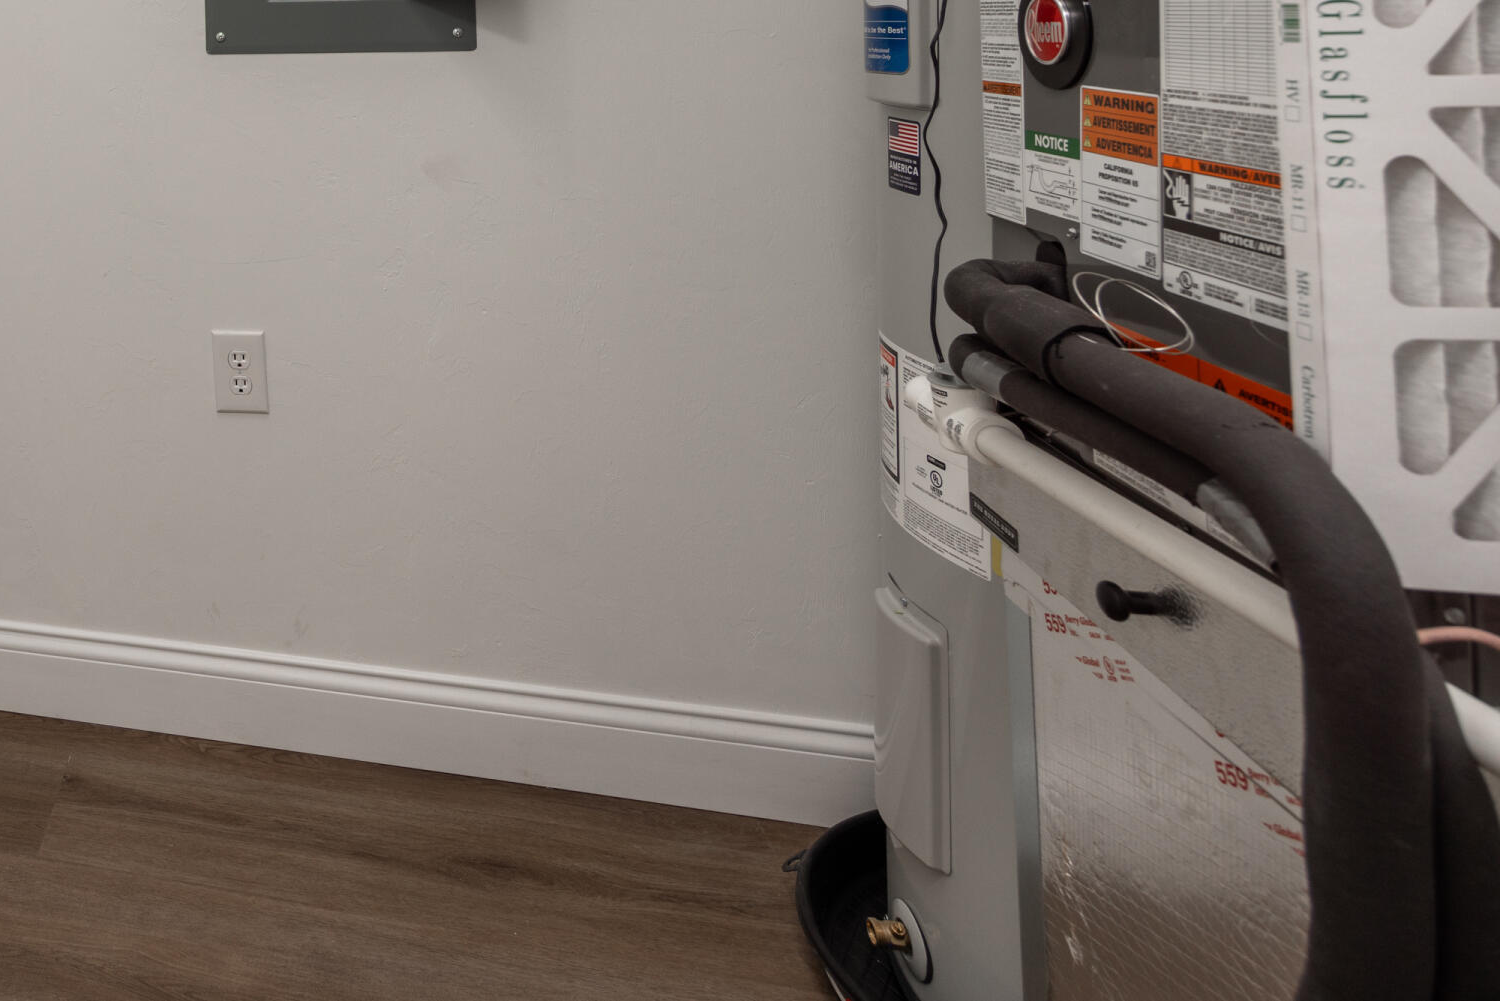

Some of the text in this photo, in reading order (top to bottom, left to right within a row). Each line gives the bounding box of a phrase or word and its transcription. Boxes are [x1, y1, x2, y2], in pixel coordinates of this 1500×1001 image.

[1028, 0, 1063, 52] Rheem
[1093, 94, 1155, 115] WARNING
[1093, 115, 1156, 137] AVERTISSEMENT
[1034, 133, 1069, 153] NOTICE
[1096, 136, 1154, 159] ADVERTENCIA
[889, 160, 919, 177] AMERICA
[1044, 612, 1066, 634] 559
[1214, 760, 1249, 791] 559
